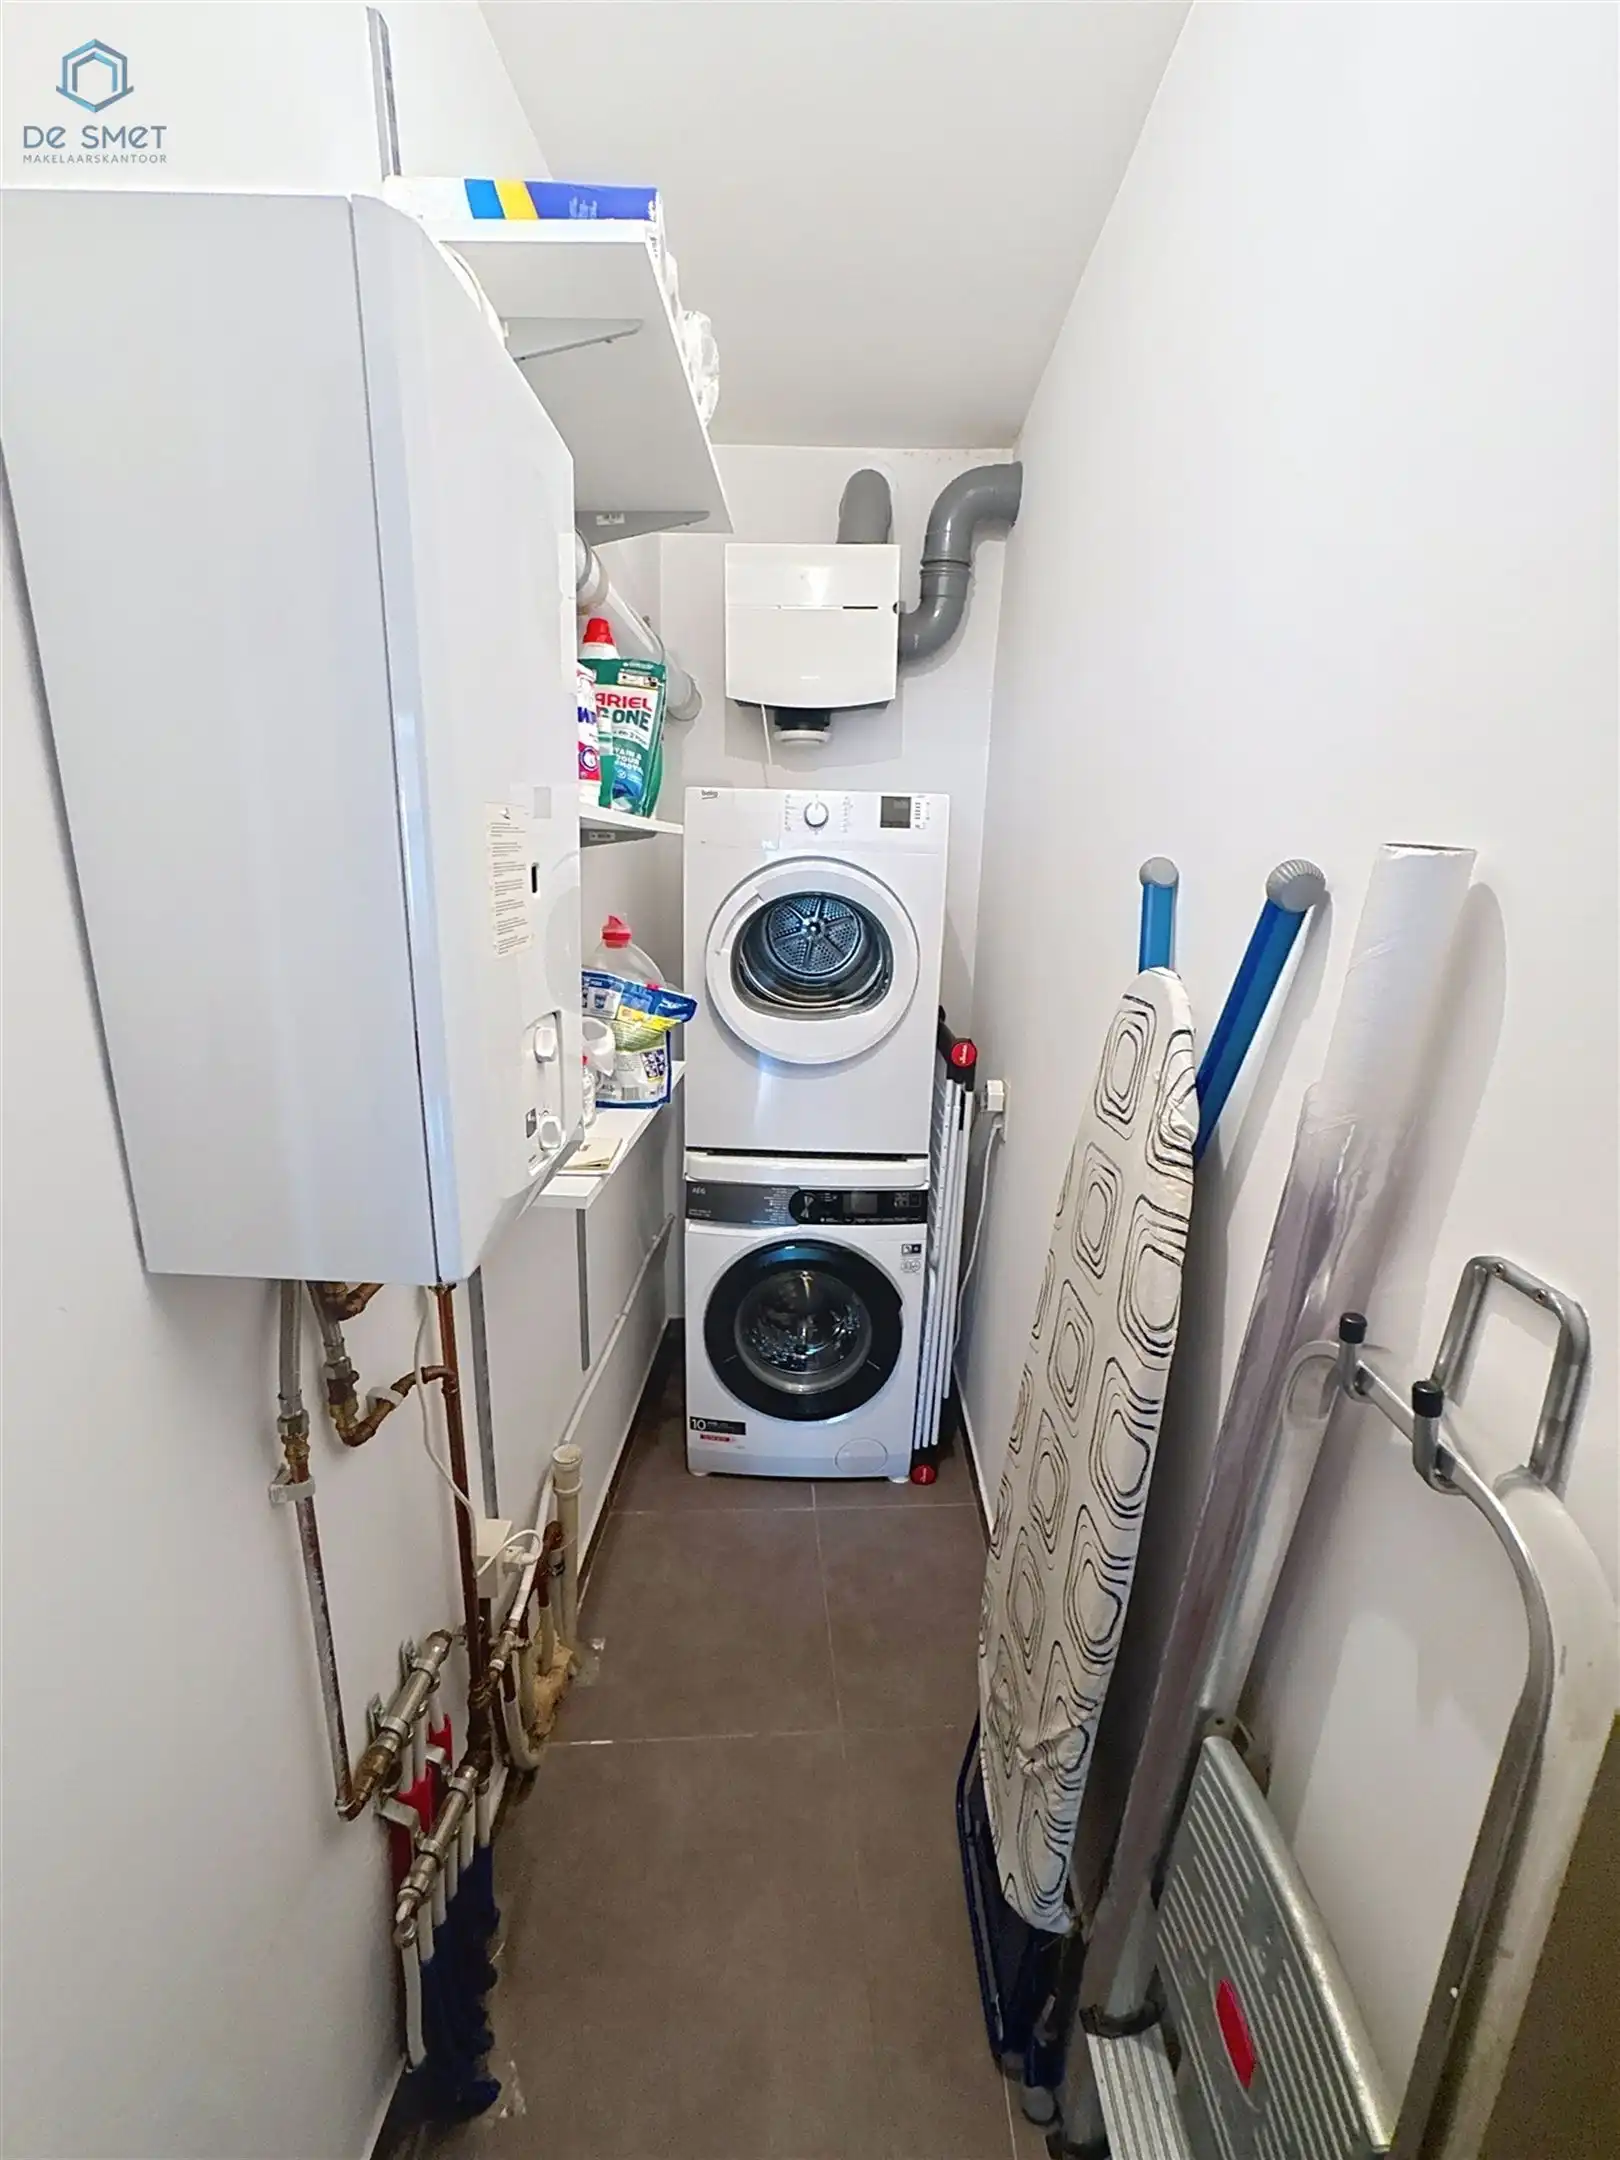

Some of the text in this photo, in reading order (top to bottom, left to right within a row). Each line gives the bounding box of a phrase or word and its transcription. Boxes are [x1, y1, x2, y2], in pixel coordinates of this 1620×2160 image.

[595, 692, 652, 712] ARIEL
[612, 709, 651, 732] ONE
[691, 1418, 706, 1431] 10
